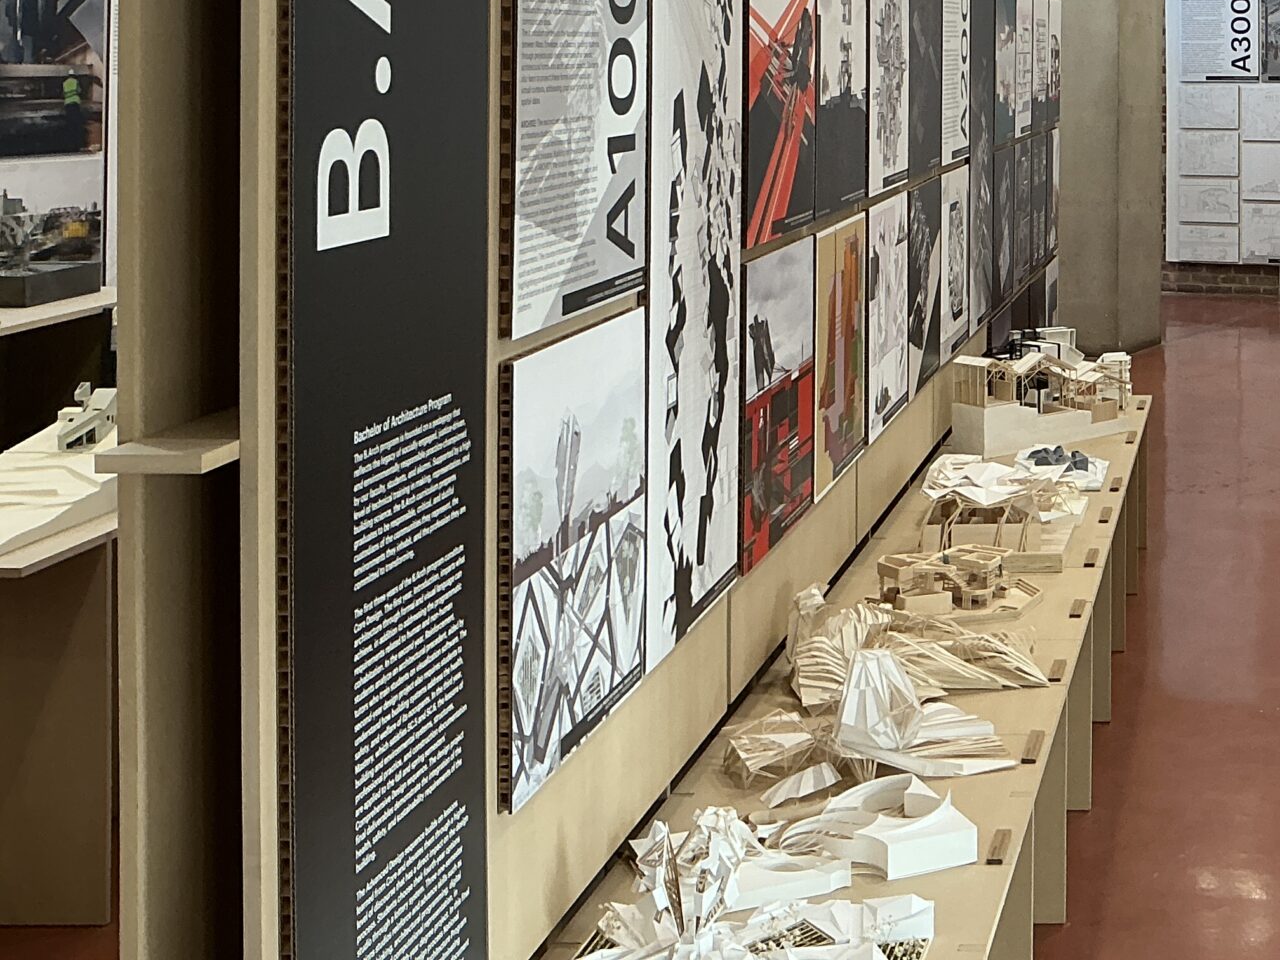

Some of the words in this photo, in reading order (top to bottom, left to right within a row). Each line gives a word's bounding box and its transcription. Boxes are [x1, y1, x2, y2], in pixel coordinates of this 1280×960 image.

[354, 423, 382, 444] Bachelor
[383, 416, 390, 431] of
[391, 404, 428, 428] Architecture
[428, 393, 452, 411] Program
